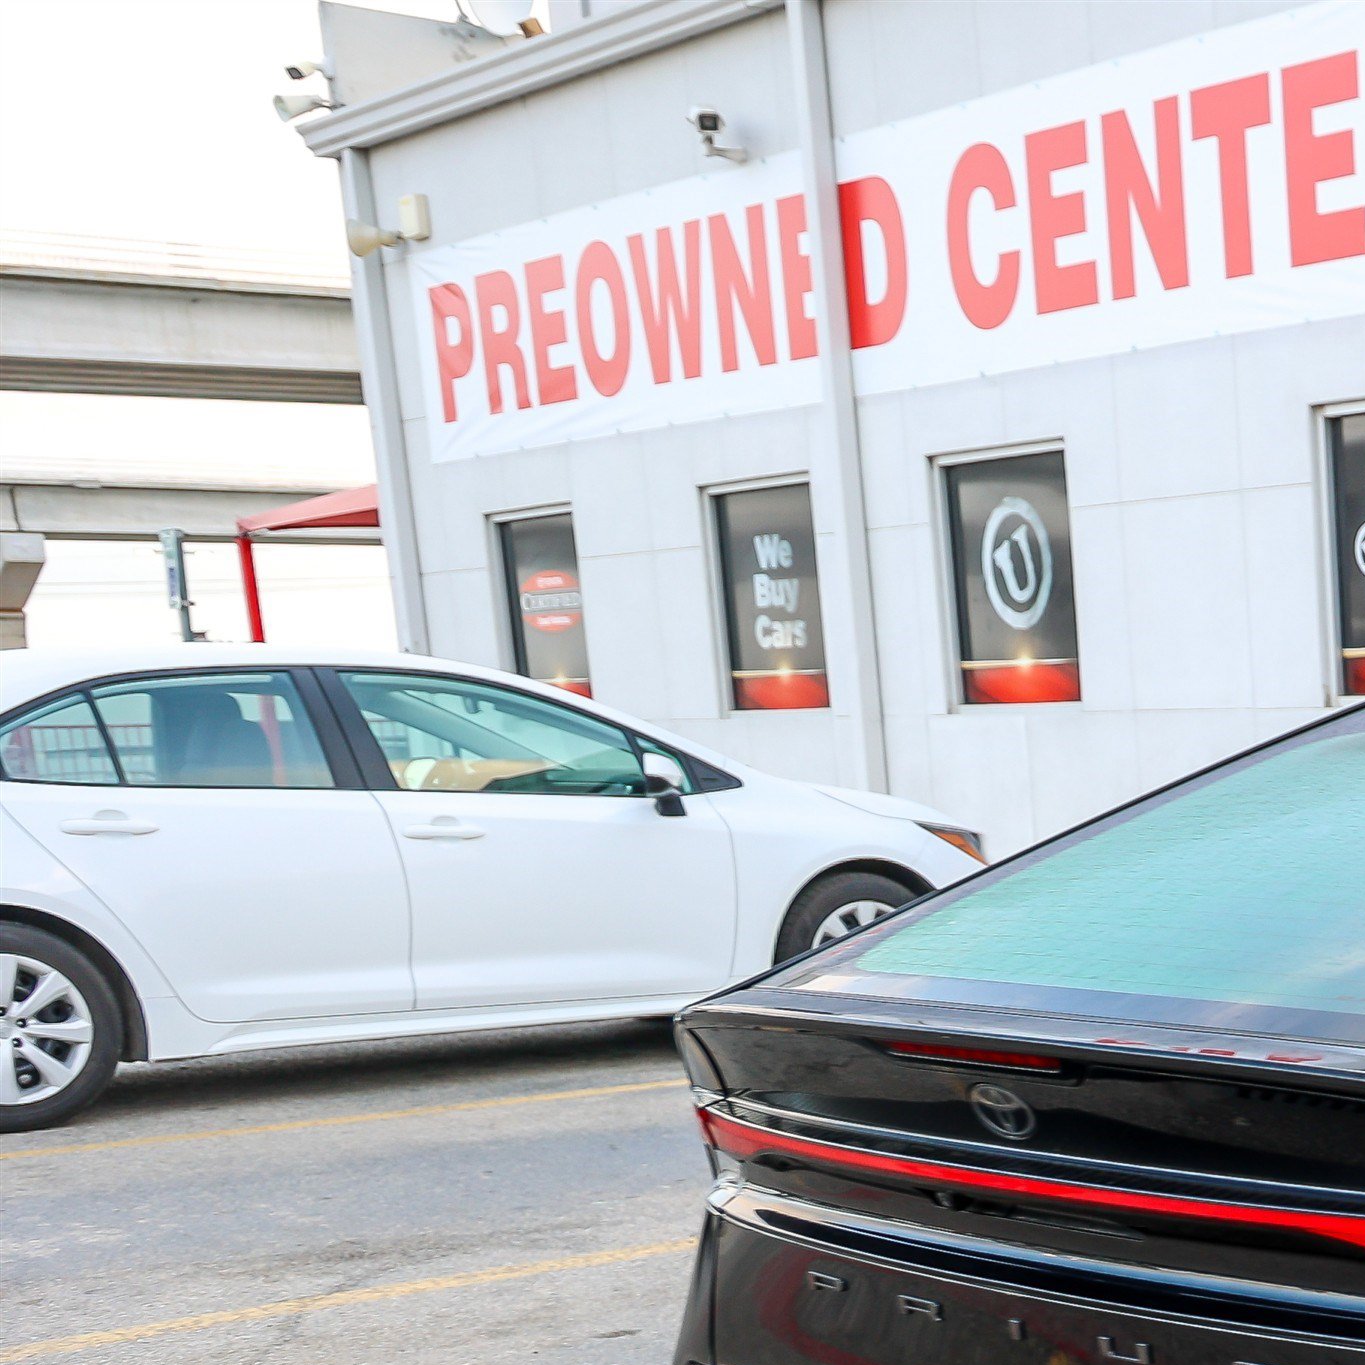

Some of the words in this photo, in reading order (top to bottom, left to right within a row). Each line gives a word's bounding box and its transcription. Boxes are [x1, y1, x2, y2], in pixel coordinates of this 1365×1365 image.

[427, 174, 909, 424] PREOWNED
[753, 533, 793, 570] We
[753, 573, 799, 613] Buy
[754, 614, 807, 650] Cars
